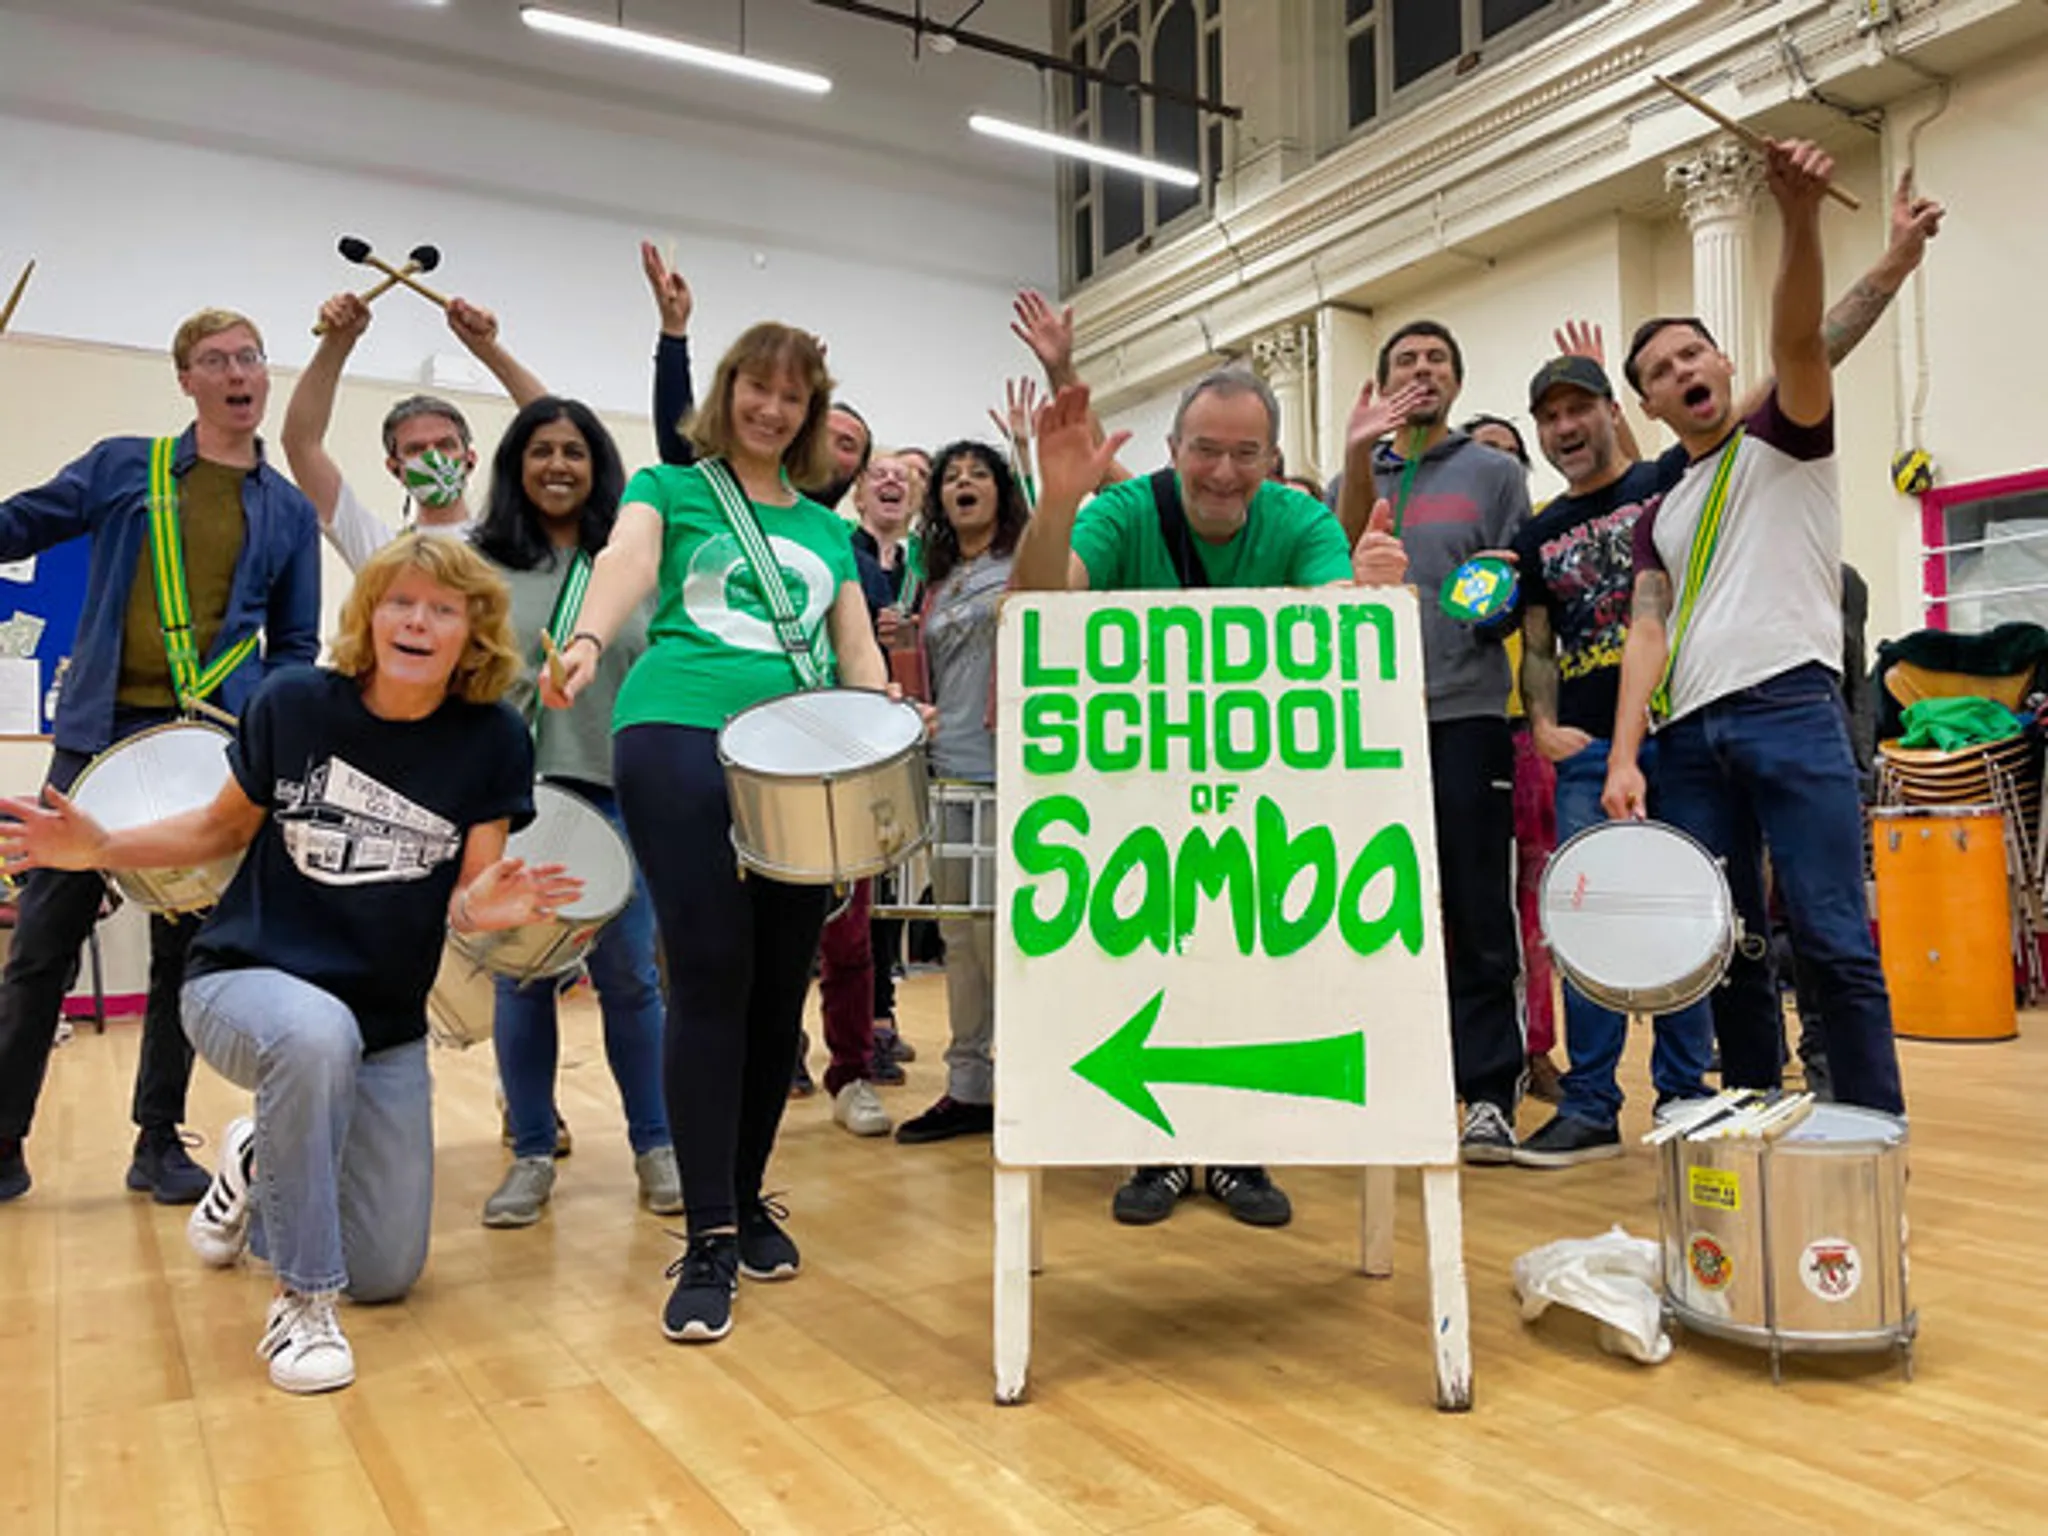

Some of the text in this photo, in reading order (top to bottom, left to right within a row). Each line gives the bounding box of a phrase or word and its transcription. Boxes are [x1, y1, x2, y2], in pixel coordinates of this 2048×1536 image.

[1022, 688, 1404, 776] SCHOOL
[1190, 783, 1240, 815] OF
[1011, 793, 1424, 959] Samba
